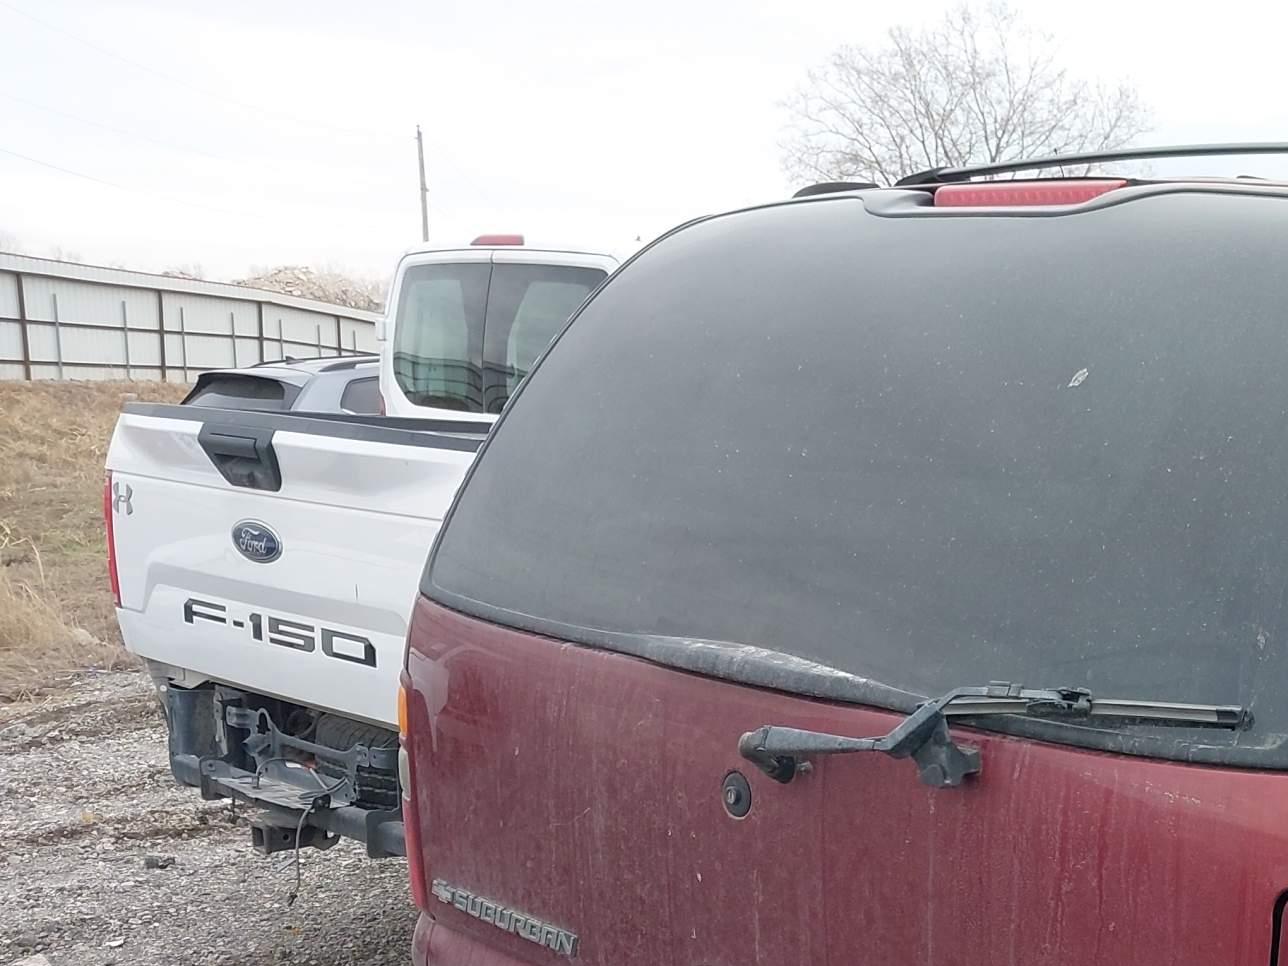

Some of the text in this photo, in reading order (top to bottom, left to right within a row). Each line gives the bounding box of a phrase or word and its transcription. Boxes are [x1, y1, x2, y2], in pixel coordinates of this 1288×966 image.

[239, 527, 269, 555] Ford
[183, 598, 378, 668] F-150
[454, 888, 579, 958] SUBURBAN
